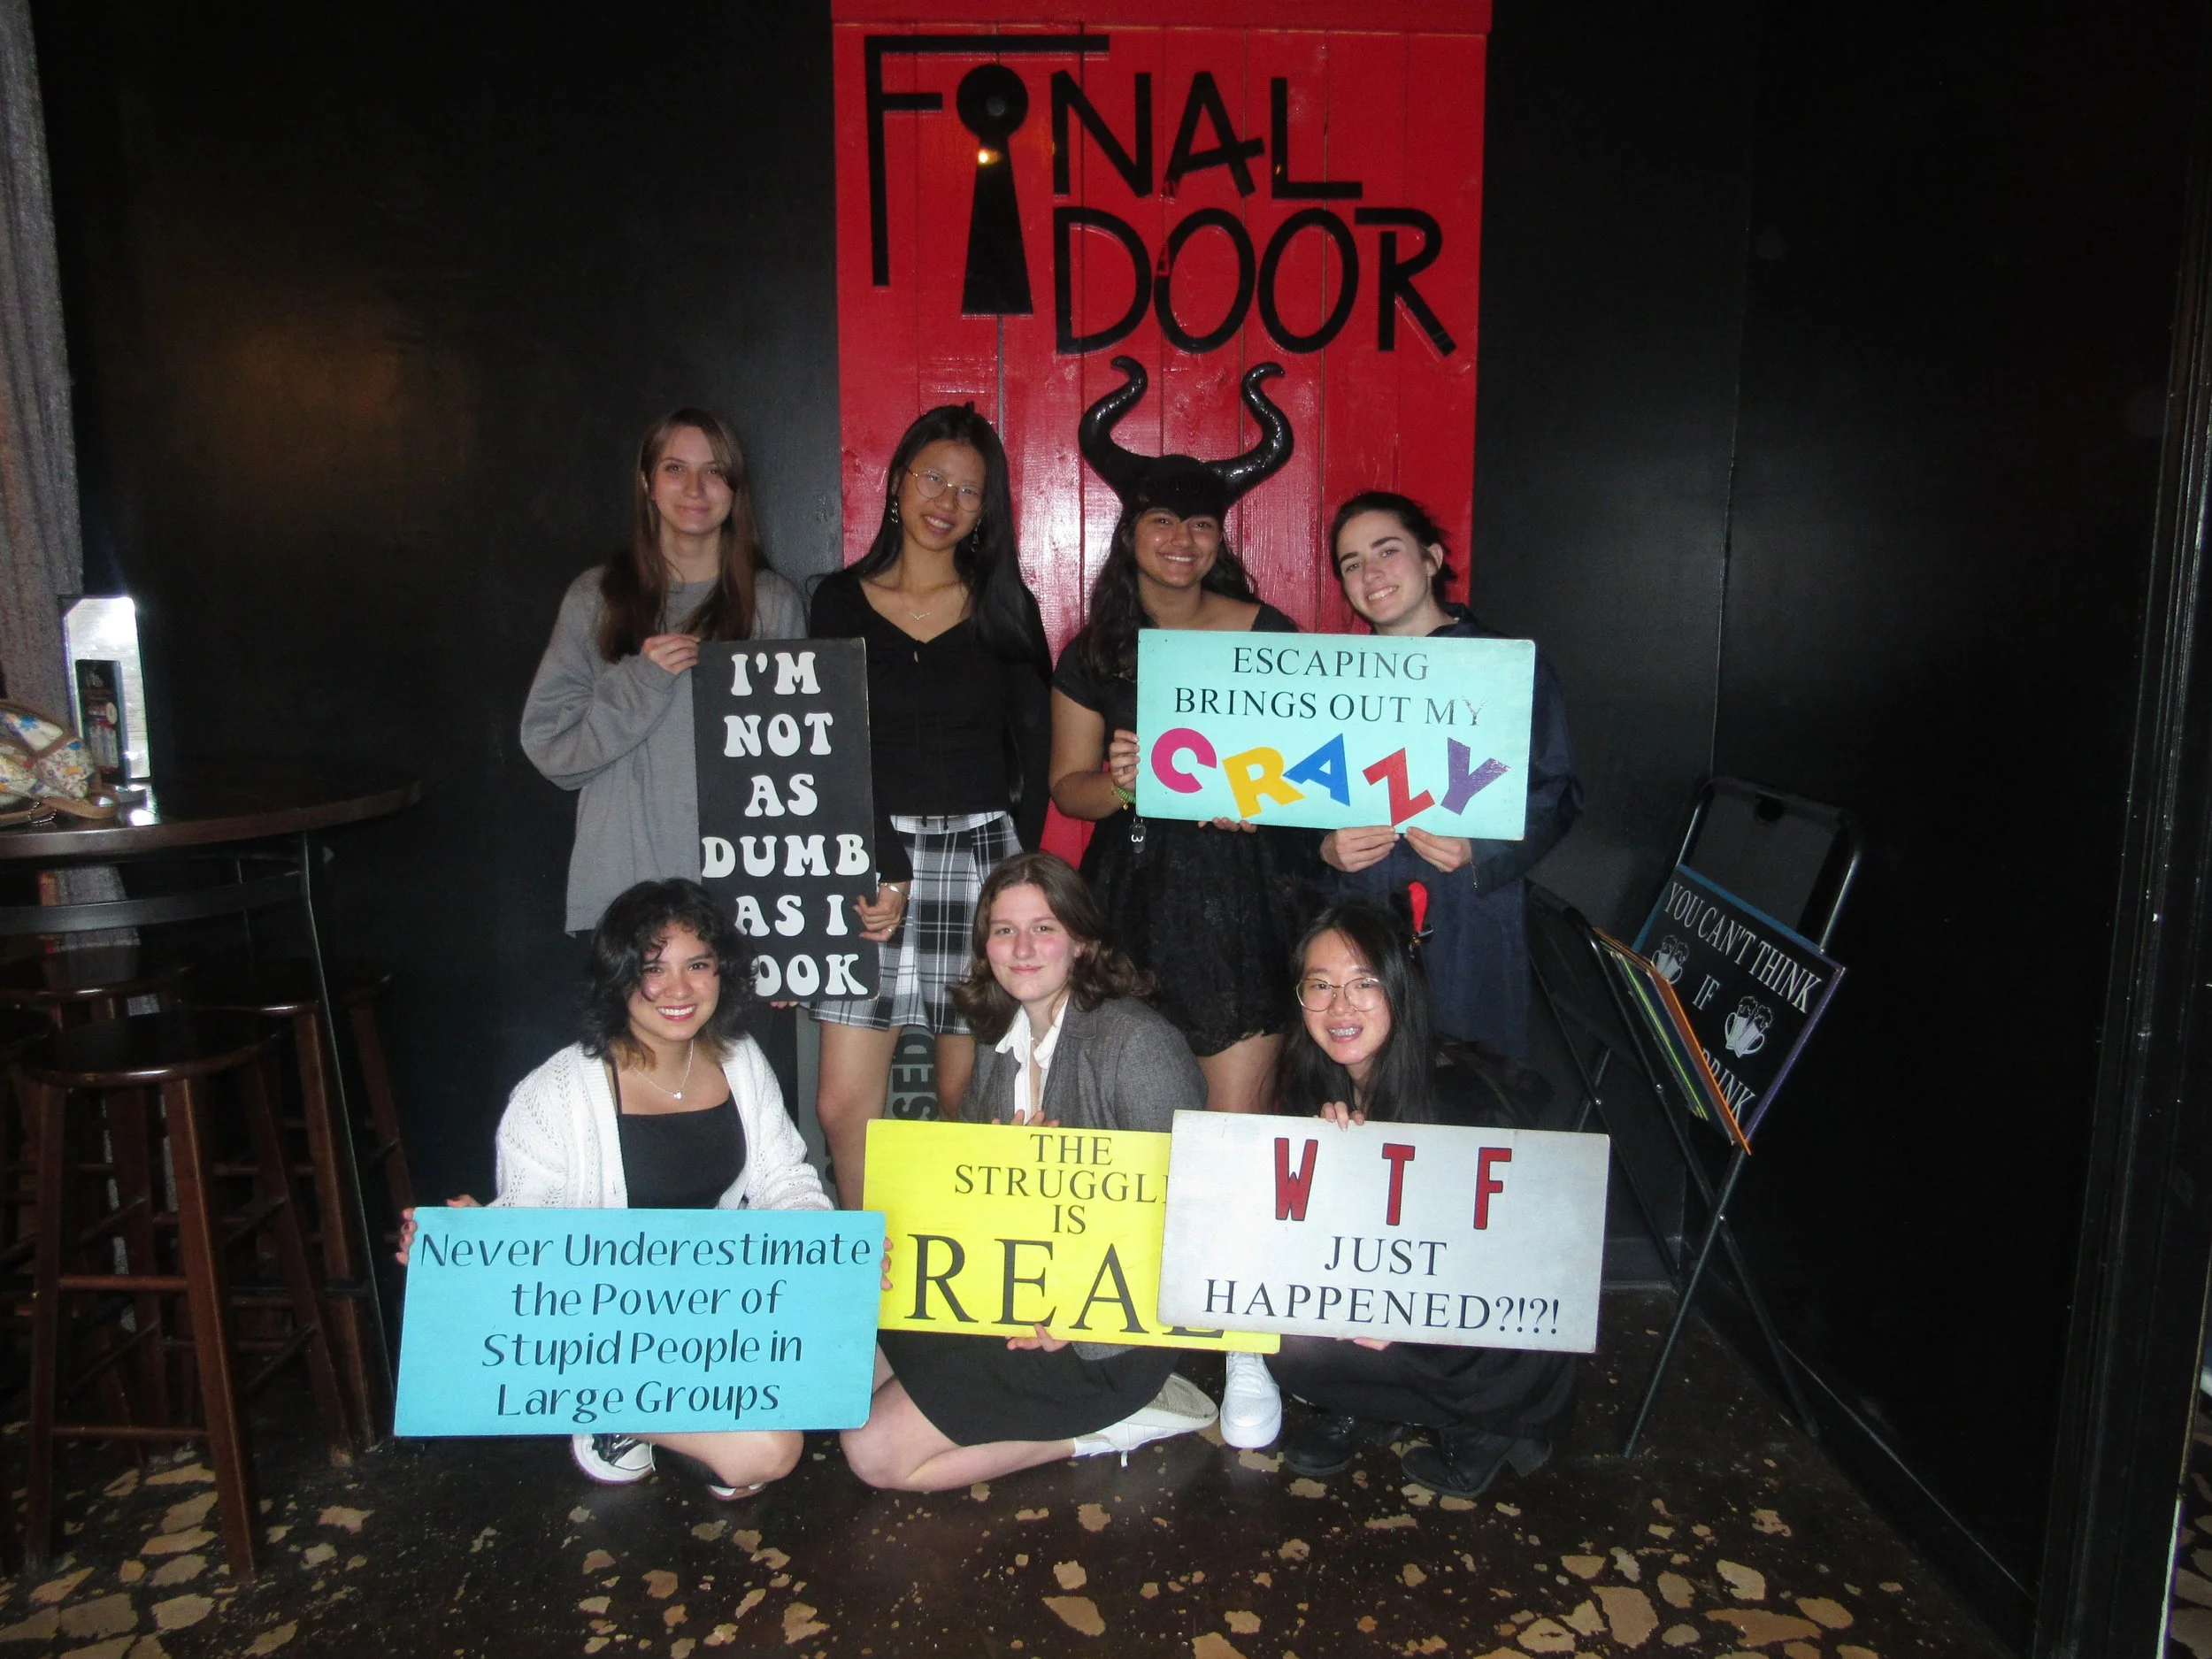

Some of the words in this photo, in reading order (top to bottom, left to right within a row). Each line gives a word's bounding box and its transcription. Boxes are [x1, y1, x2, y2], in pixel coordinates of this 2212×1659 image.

[864, 35, 1363, 316] FINAL
[1053, 206, 1455, 357] DOOR
[730, 651, 822, 697] I'M
[1232, 646, 1429, 681] ESCAPING
[1173, 687, 1317, 719] BRINGS
[1329, 694, 1411, 723] OUT
[1425, 697, 1489, 726] MY
[723, 712, 833, 758] NOT
[744, 773, 818, 818] AS
[1150, 727, 1511, 827] CRAZY
[701, 834, 871, 879] DUMB
[734, 895, 805, 938] AS
[826, 895, 849, 937] I
[1663, 882, 1705, 927] YOU
[1697, 906, 1756, 965] CAN'T
[1748, 940, 1822, 1014] THINK
[751, 954, 869, 997] OOK
[1692, 974, 1721, 1011] IF
[1030, 1133, 1112, 1166] THE
[1051, 1204, 1087, 1234] IS
[420, 1233, 554, 1267] Never
[565, 1232, 871, 1266] Underestimate
[1325, 1236, 1448, 1277] JUST
[511, 1281, 581, 1317] the
[593, 1282, 731, 1316] Power
[741, 1279, 787, 1314] of
[903, 1233, 1225, 1339] REA
[1202, 1279, 1560, 1335] HAPPENED?!?!
[481, 1330, 620, 1375] Stupid
[630, 1329, 759, 1372] People
[771, 1329, 803, 1363] in
[497, 1383, 624, 1424] Large
[635, 1379, 780, 1419] Groups
